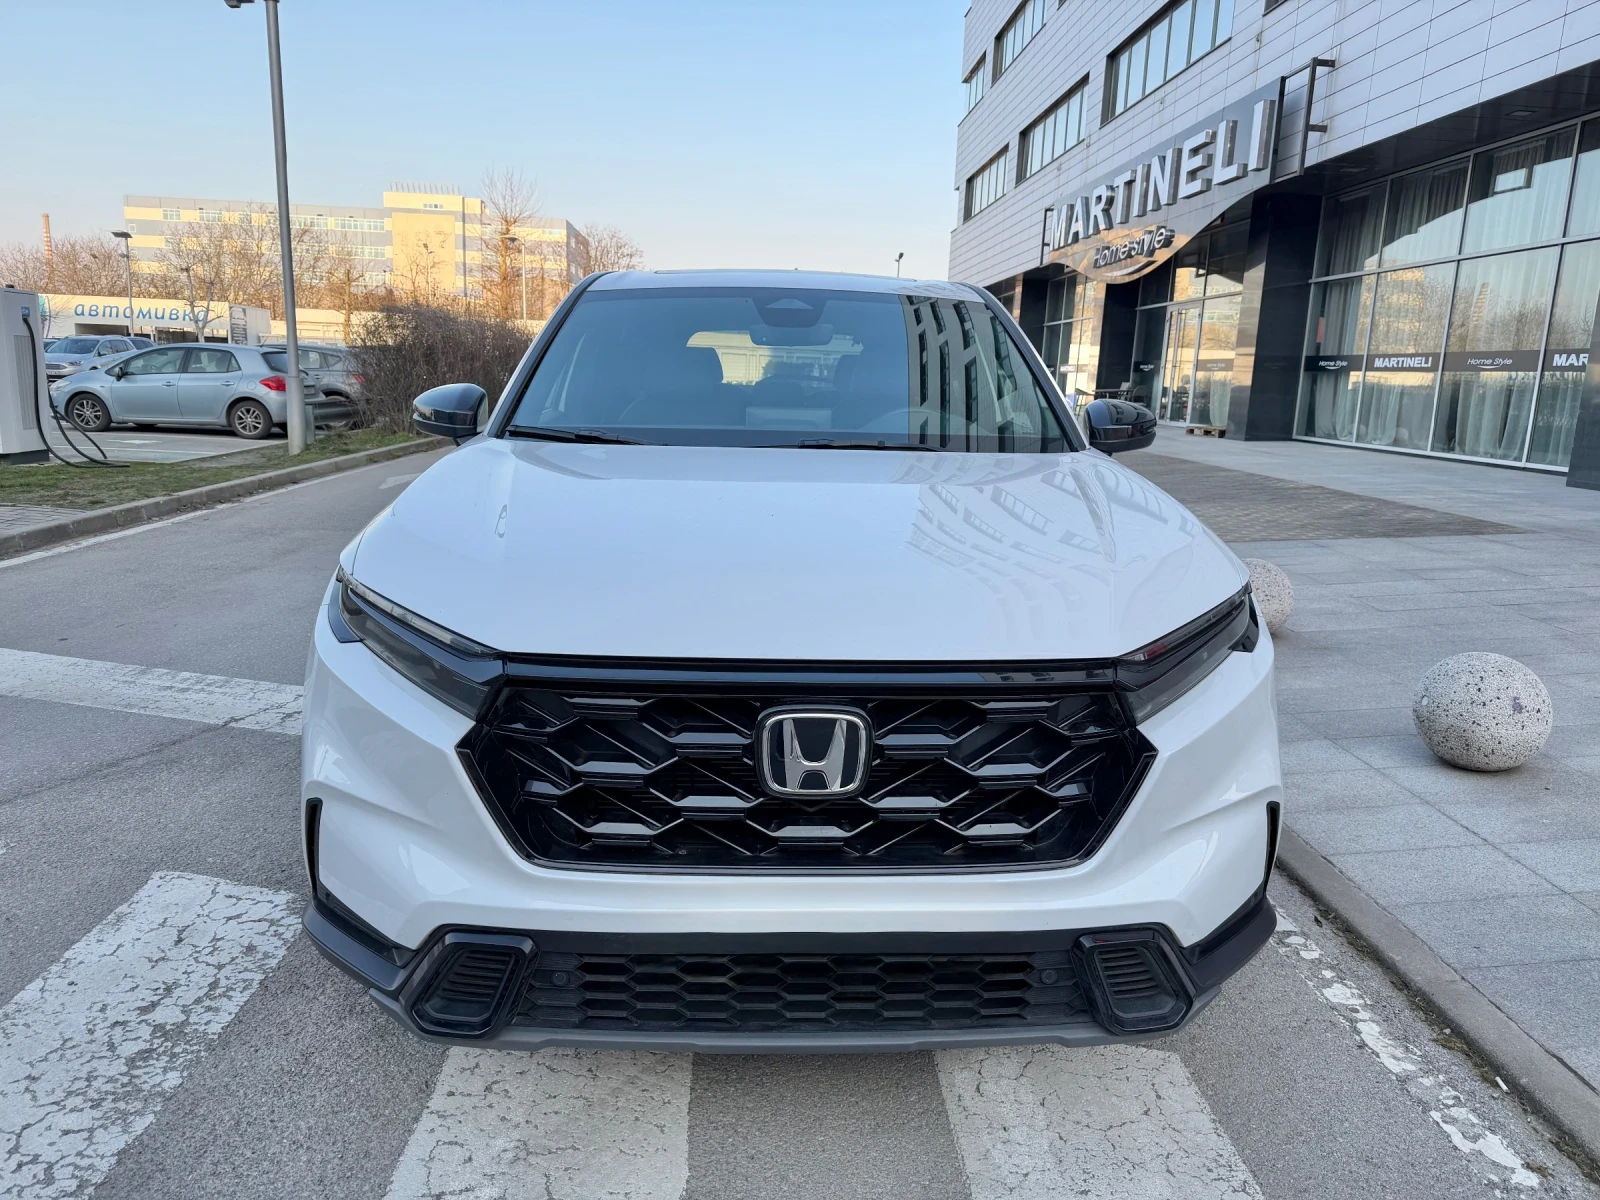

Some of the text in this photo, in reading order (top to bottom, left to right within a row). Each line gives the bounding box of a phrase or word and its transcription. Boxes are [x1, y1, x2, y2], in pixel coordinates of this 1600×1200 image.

[1050, 99, 1276, 252] MARTINELI
[1093, 241, 1131, 269] Home
[74, 303, 207, 322] автомивка
[1374, 356, 1432, 368] MARTINELI
[1493, 357, 1513, 367] Style
